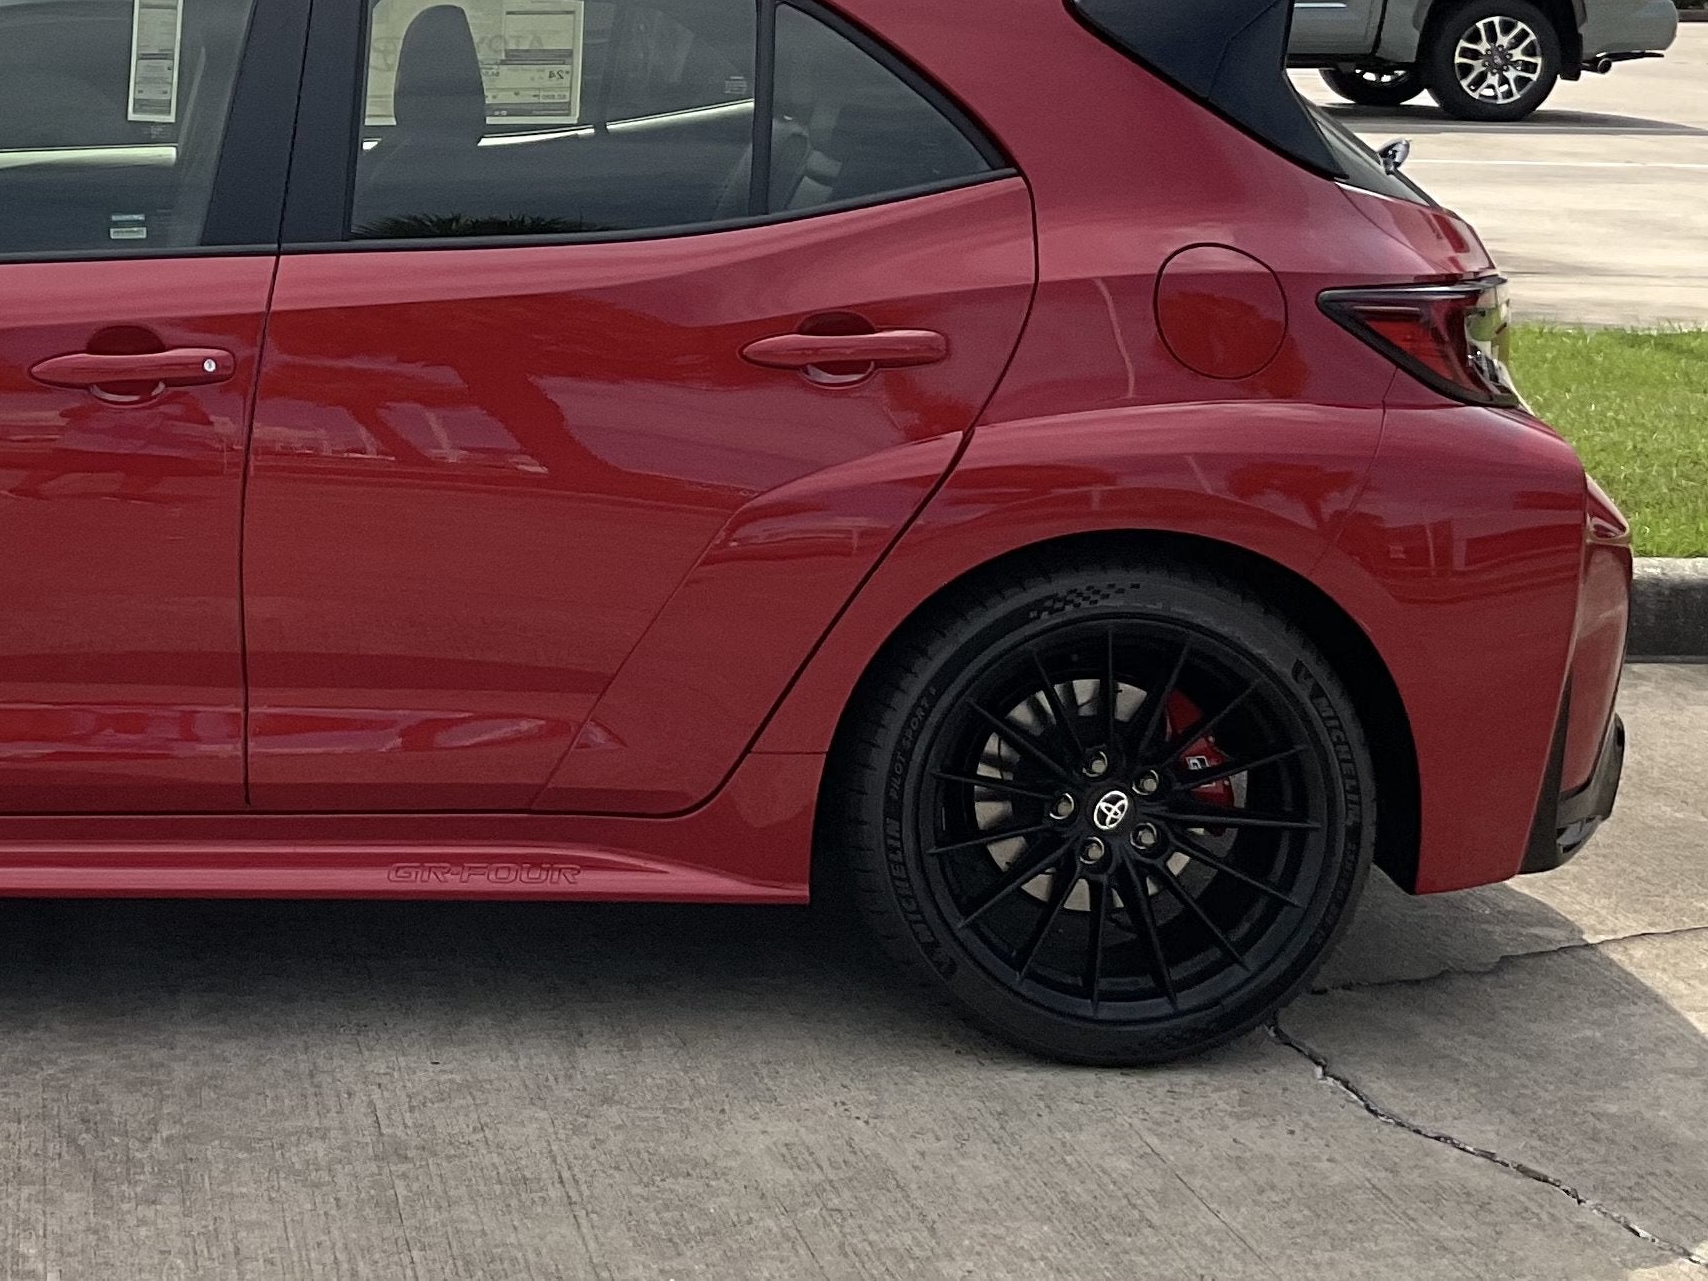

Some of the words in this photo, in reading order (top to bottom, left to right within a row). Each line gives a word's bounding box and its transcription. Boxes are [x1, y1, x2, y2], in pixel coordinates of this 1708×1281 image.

[900, 696, 932, 749] SPORT
[889, 751, 907, 799] PILOT
[1311, 693, 1359, 822] MICHELIN
[387, 863, 581, 884] GR-FOUR
[886, 816, 934, 948] MICHELIN
